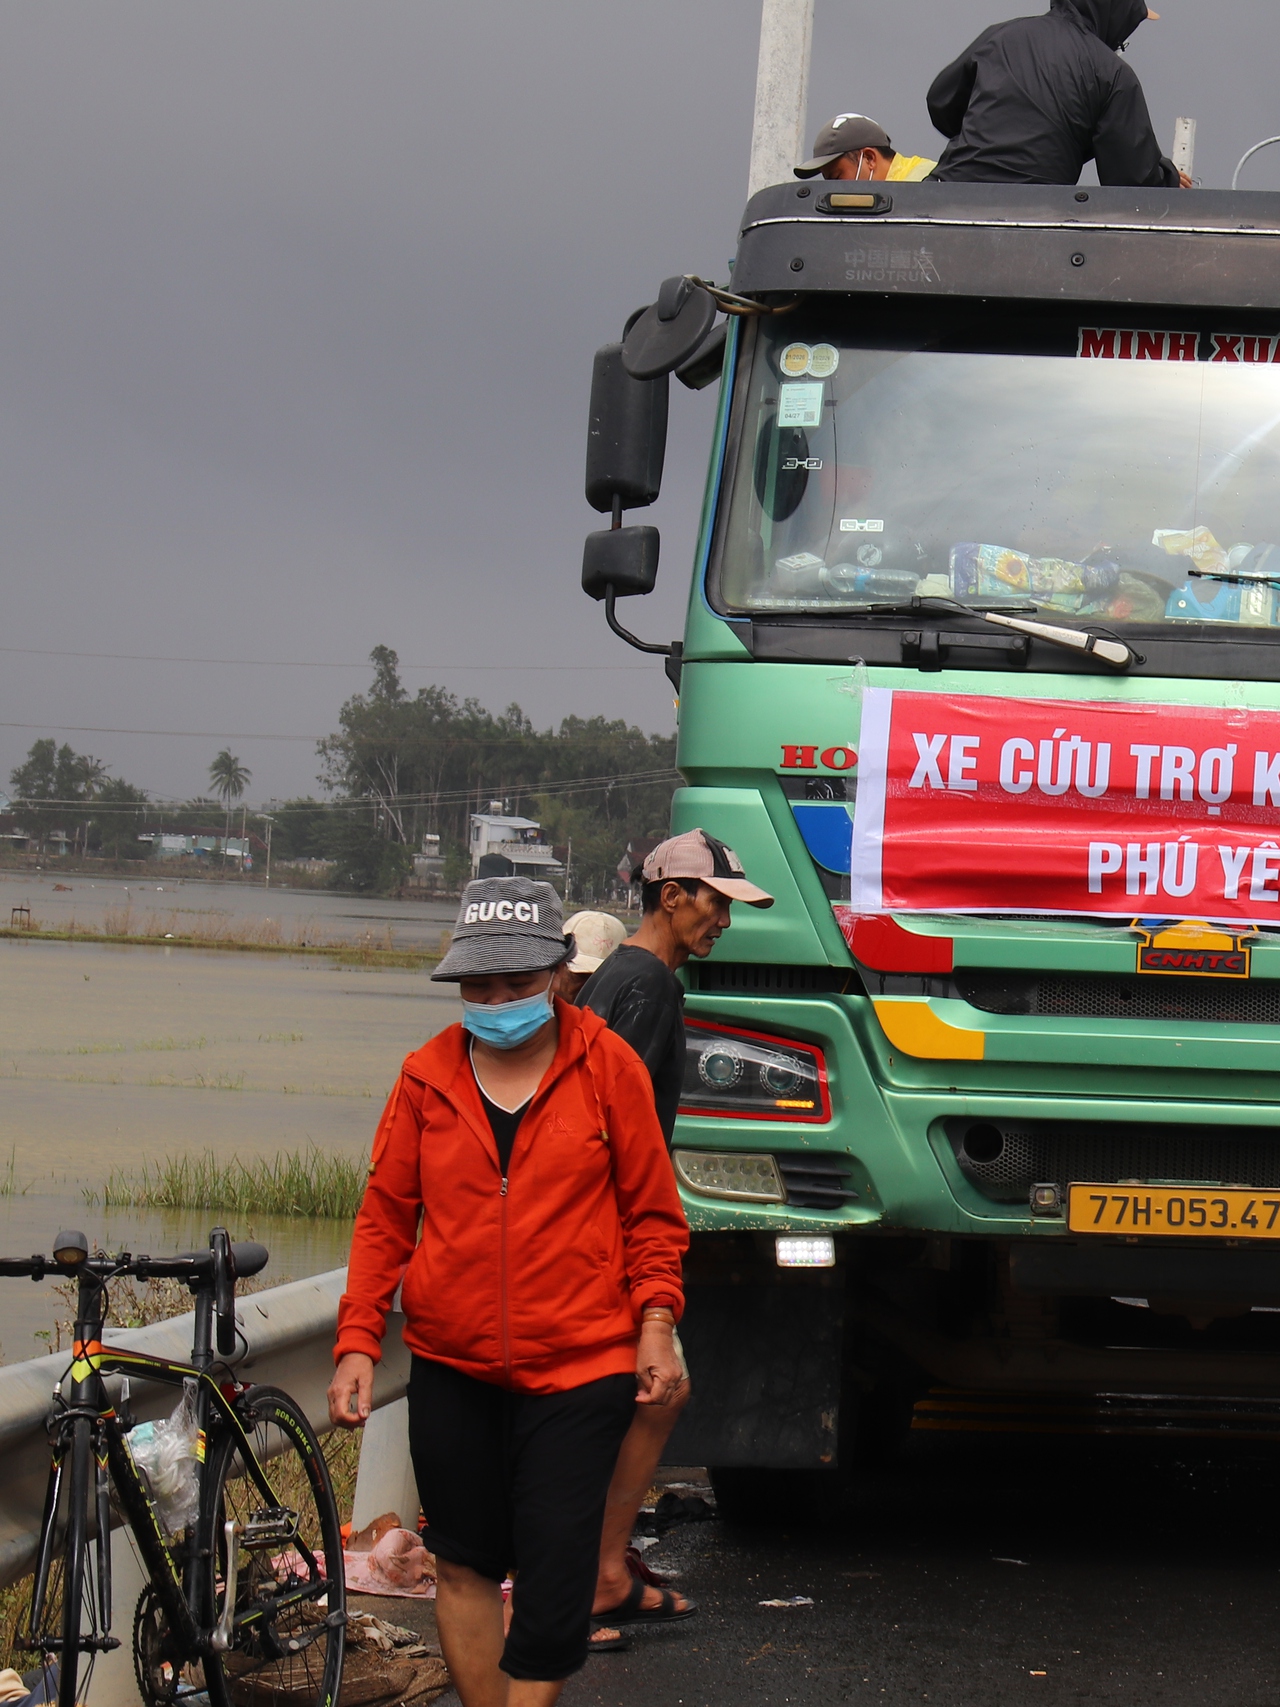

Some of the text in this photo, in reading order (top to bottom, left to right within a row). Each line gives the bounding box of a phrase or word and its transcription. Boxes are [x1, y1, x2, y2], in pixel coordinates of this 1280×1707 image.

[845, 269, 933, 282] SINOTRUK
[1078, 327, 1200, 361] MINH
[908, 732, 981, 791] XE
[998, 728, 1112, 799] CỨU
[1130, 743, 1238, 816] TRỢ
[1087, 835, 1200, 898] PHÚ
[465, 900, 540, 924] GUCCI
[1144, 953, 1243, 970] CNHTC
[1089, 1195, 1280, 1229] 77H-053.47
[274, 1408, 313, 1456] ROAD BIKE
